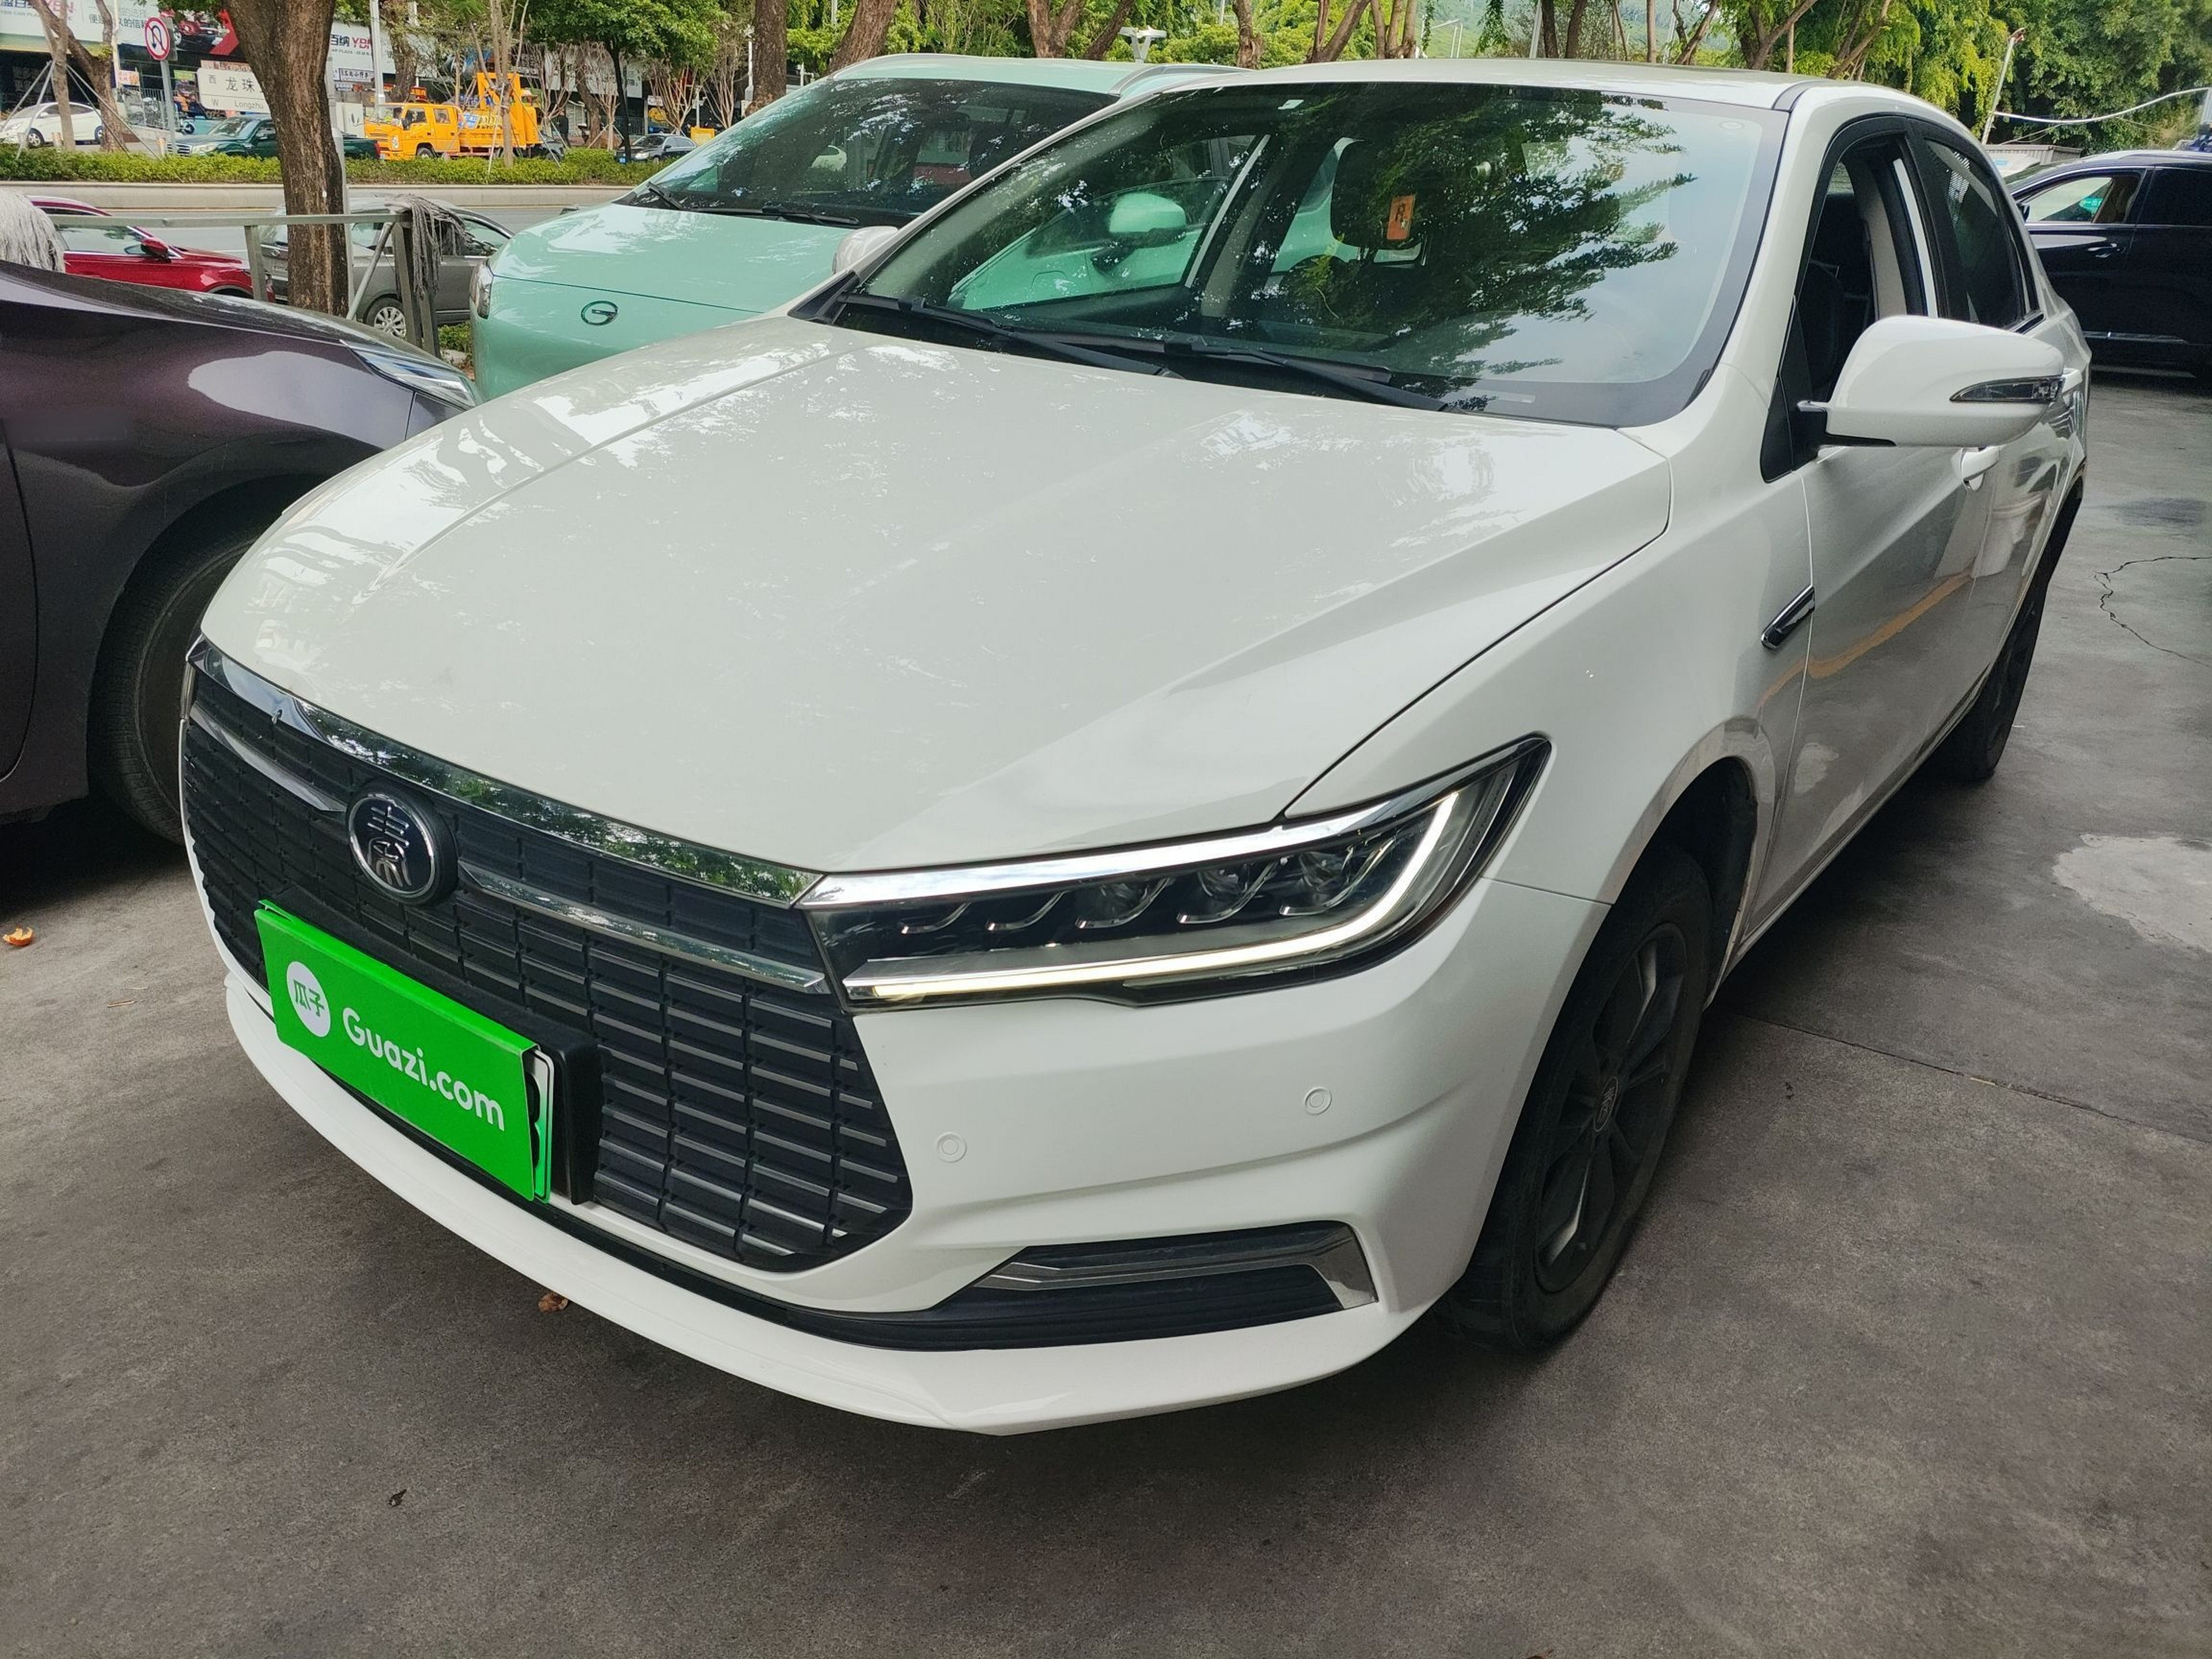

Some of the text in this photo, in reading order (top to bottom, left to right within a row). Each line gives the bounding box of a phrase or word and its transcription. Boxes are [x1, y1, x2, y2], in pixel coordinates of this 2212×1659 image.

[225, 77, 262, 93] 龙珠
[211, 99, 264, 109] W Longzhu
[294, 979, 324, 1018] 瓜子
[343, 1007, 505, 1131] Guazi.com
